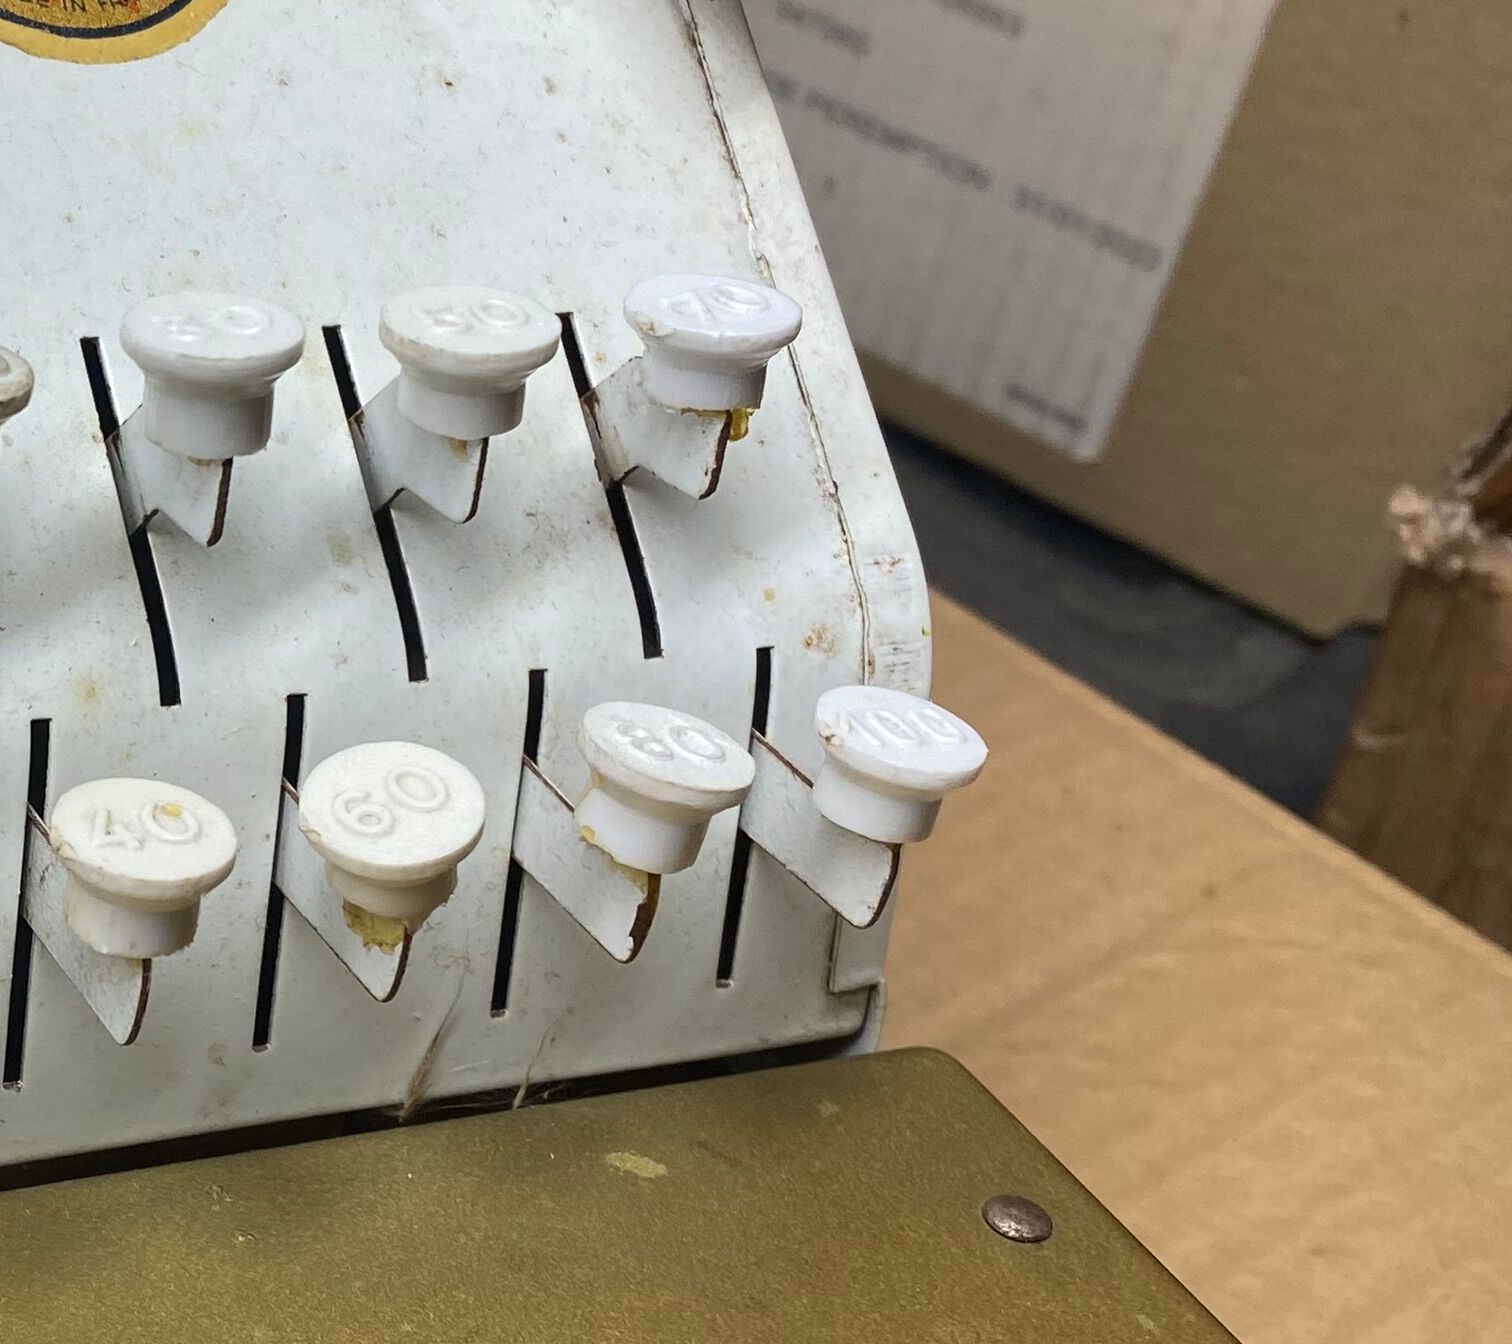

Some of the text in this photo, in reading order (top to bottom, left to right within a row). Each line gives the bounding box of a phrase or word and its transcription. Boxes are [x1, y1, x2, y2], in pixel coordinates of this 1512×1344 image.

[410, 298, 531, 335] 50
[657, 283, 771, 329] 70
[609, 713, 727, 764] 80
[838, 707, 969, 749] 100
[90, 801, 202, 851] 40
[332, 765, 451, 840] 60
